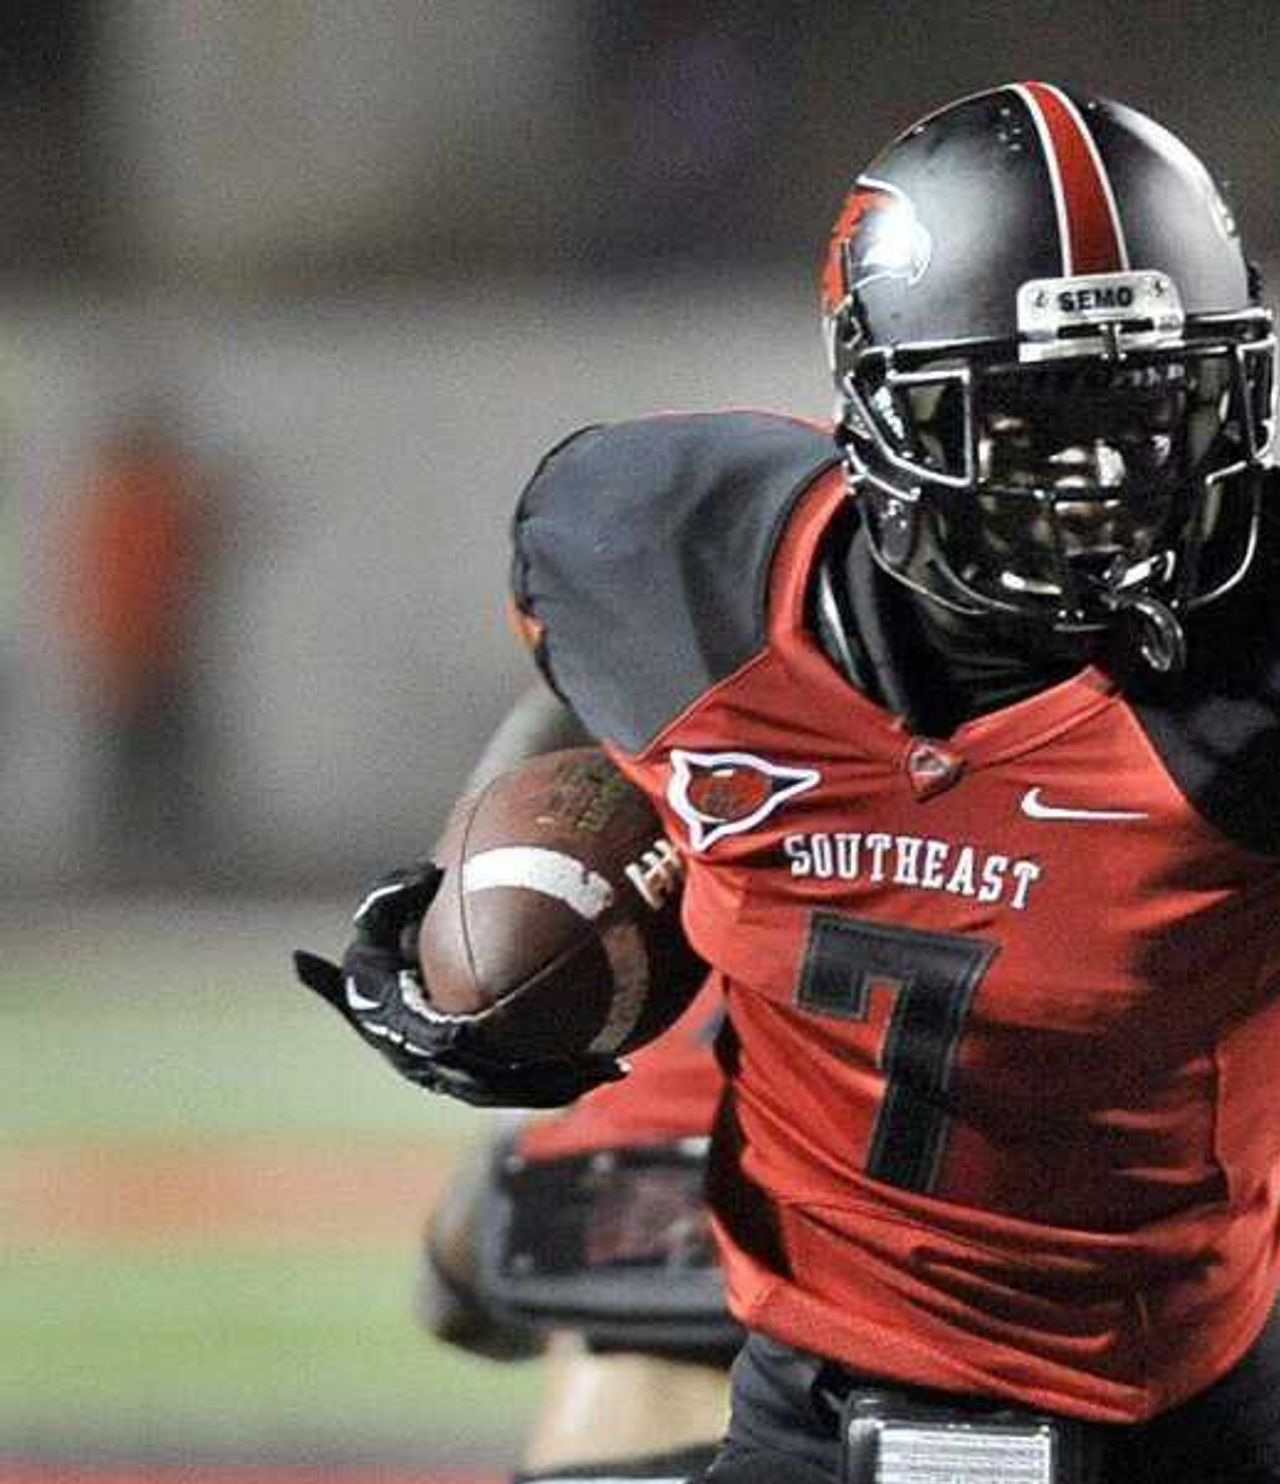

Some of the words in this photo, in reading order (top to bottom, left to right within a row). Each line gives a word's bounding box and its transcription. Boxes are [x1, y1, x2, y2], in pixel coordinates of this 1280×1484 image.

[1057, 286, 1134, 313] SEMO
[784, 833, 1041, 910] SOUTHEAST
[793, 908, 1001, 1194] 7
